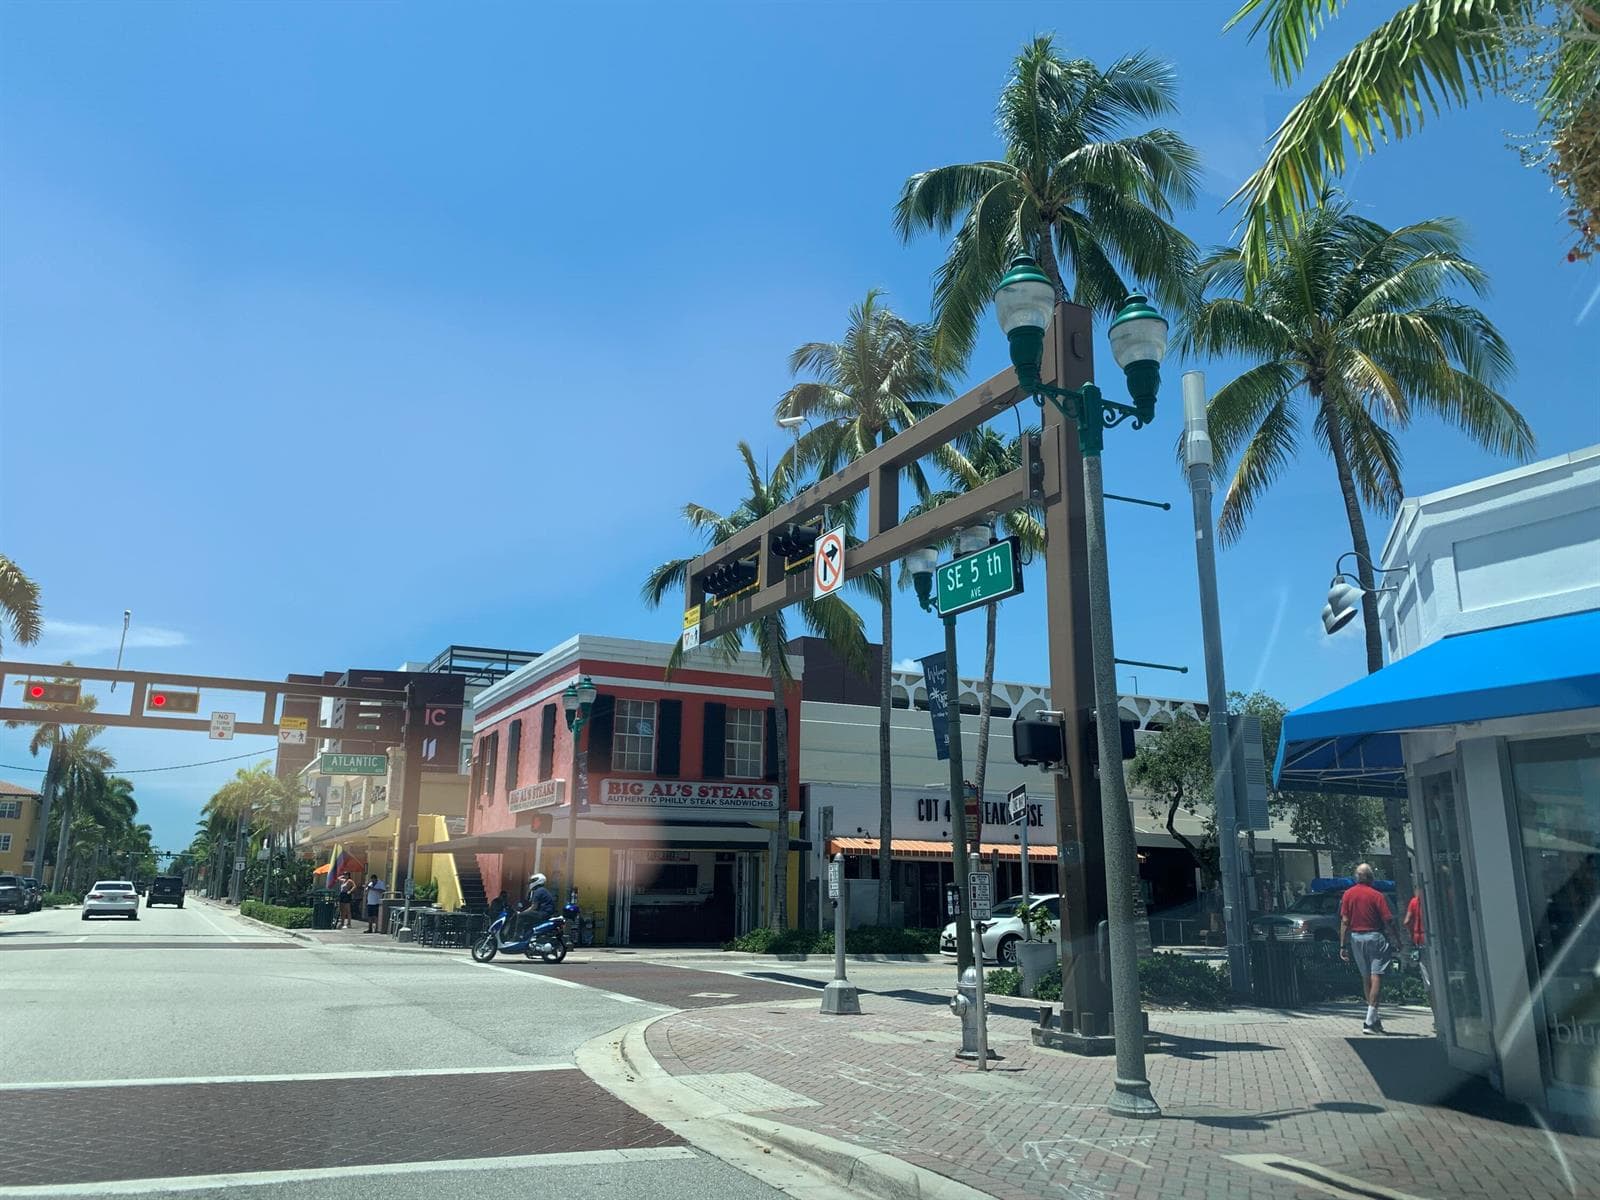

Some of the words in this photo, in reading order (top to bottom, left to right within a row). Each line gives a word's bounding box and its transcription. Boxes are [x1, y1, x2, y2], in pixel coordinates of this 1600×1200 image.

[947, 565, 964, 591] SE
[971, 558, 979, 583] 5
[971, 586, 982, 599] AVE
[331, 756, 378, 767] ATLANTIC
[608, 782, 644, 796] BIG
[649, 783, 693, 797] AL'S
[698, 786, 773, 800] STEAKS
[720, 799, 774, 807] SANDWICHES
[918, 799, 939, 822] CUT
[1552, 1012, 1600, 1045] blu
